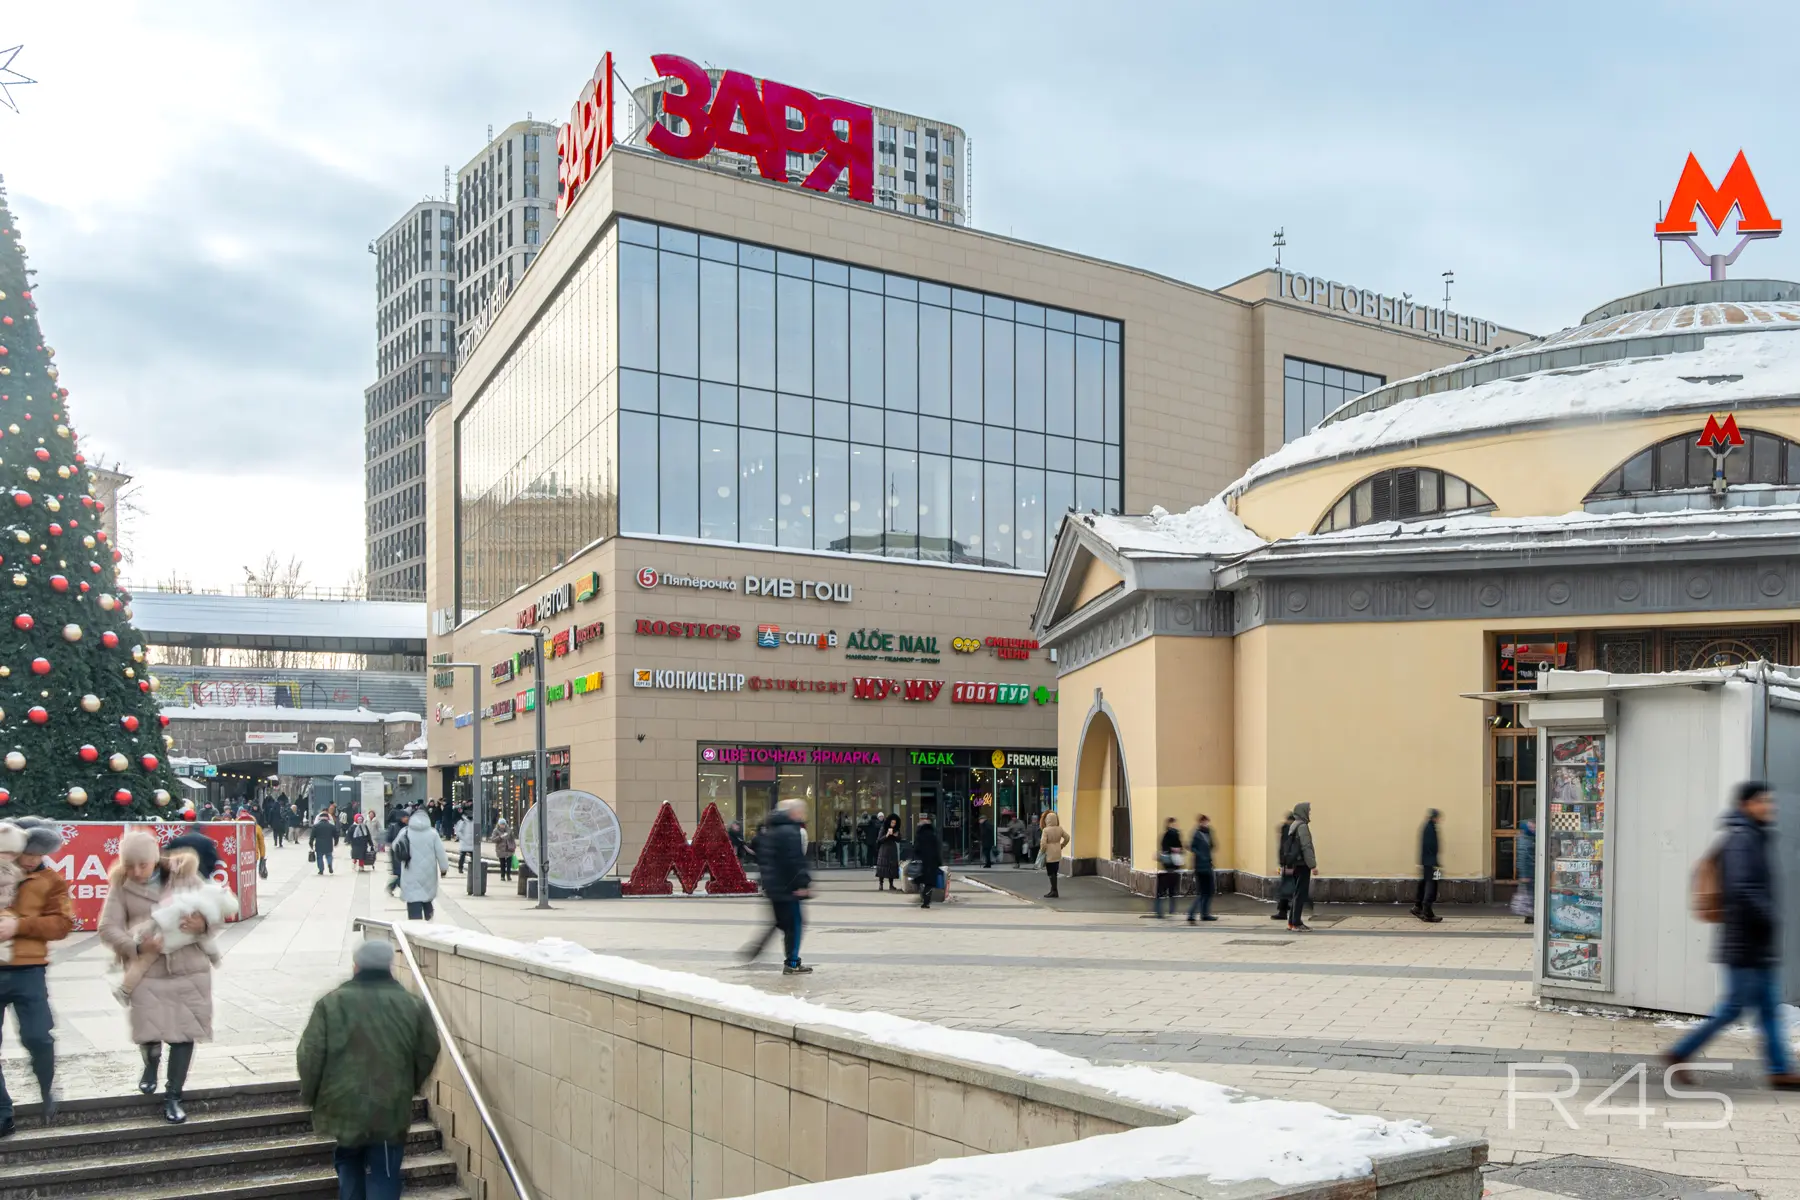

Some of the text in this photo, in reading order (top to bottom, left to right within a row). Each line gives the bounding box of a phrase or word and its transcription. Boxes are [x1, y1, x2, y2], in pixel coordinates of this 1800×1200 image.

[647, 53, 873, 203] ЗАРЯ
[1276, 267, 1499, 347] ТОРГОВЫЙ ЦЕНТР
[662, 572, 737, 591] Пятёрочка
[744, 575, 853, 602] РИВ ГОШ
[636, 619, 741, 641] ROSTIC'S
[785, 630, 838, 651] СПЛАВ
[847, 630, 941, 655] ALOE NAIL
[655, 669, 745, 692] КОПИЦЕНТР
[765, 678, 848, 694] SUNLIGHT
[718, 748, 806, 763] ЦВЕТОЧНАЯ
[811, 750, 880, 765] ЯРМАРКА
[911, 752, 954, 765] ТАБАК
[1007, 753, 1058, 767] FRENCH BAKE
